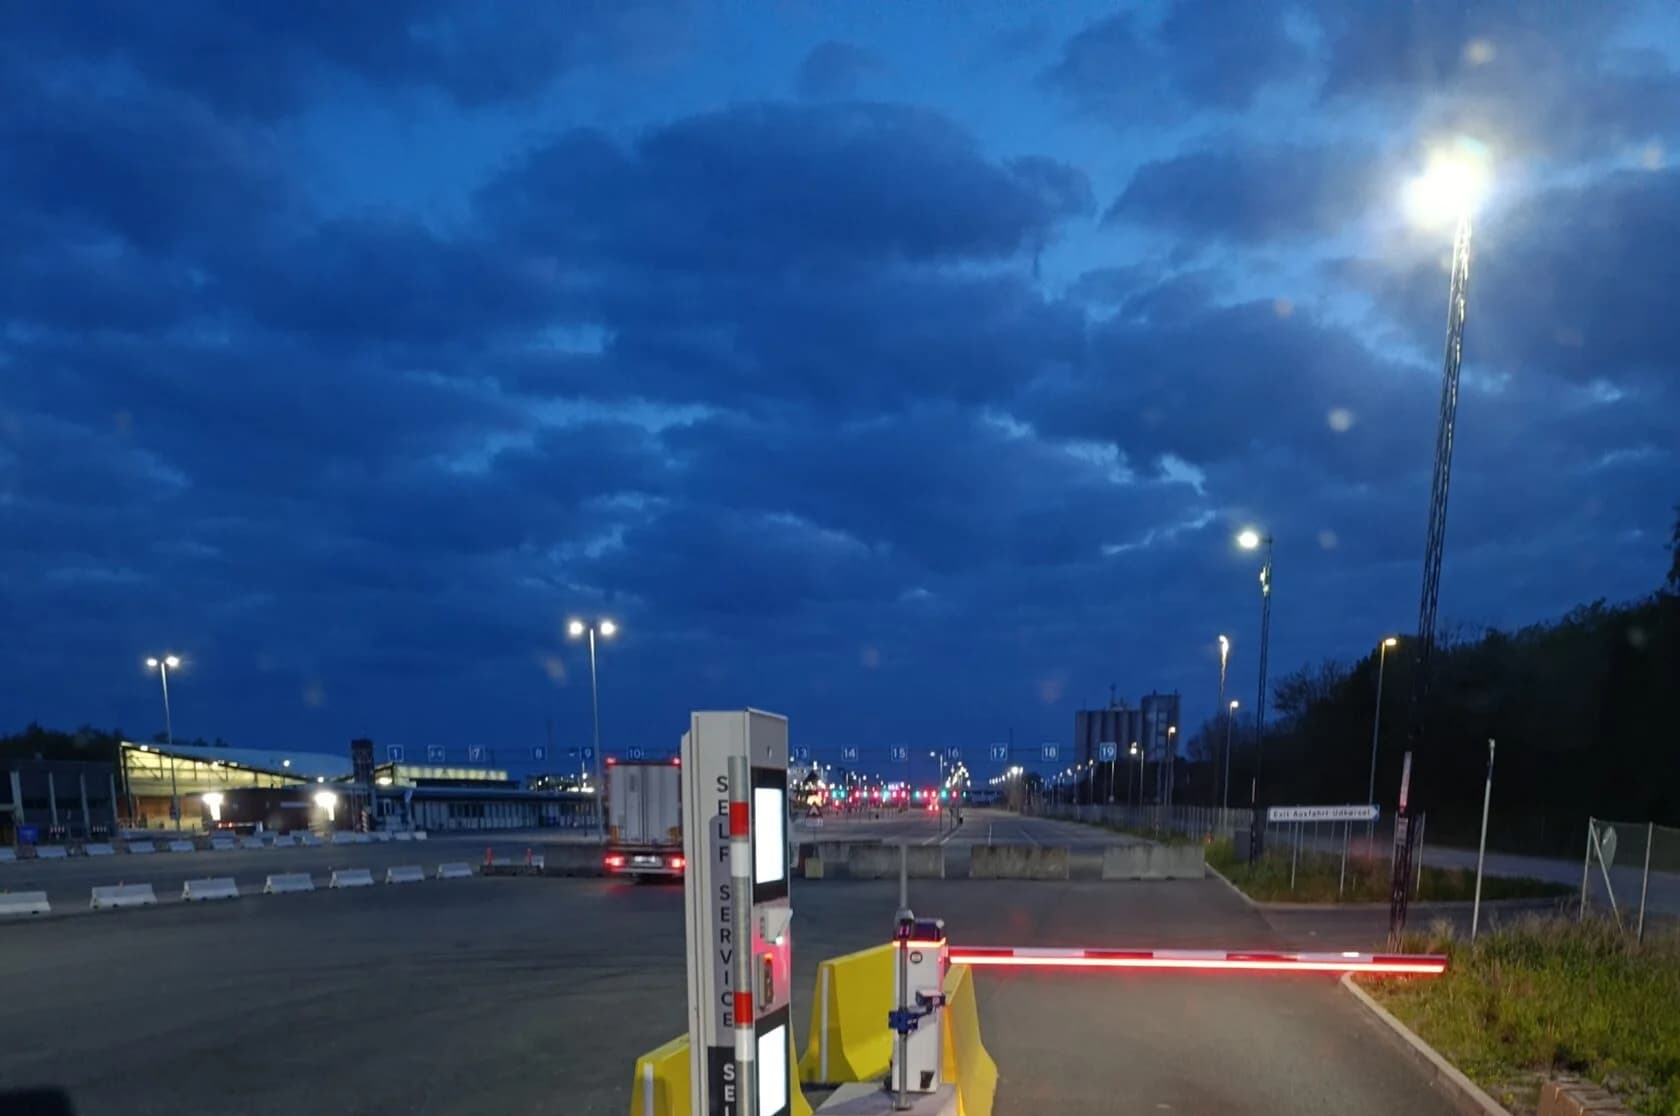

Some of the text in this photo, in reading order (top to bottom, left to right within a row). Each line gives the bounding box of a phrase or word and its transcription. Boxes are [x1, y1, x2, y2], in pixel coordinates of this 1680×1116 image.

[993, 747, 1005, 758] 17
[1103, 747, 1114, 757] 19
[1293, 809, 1329, 817] Ausfahrt
[717, 775, 733, 1028] SELF SERVICE
